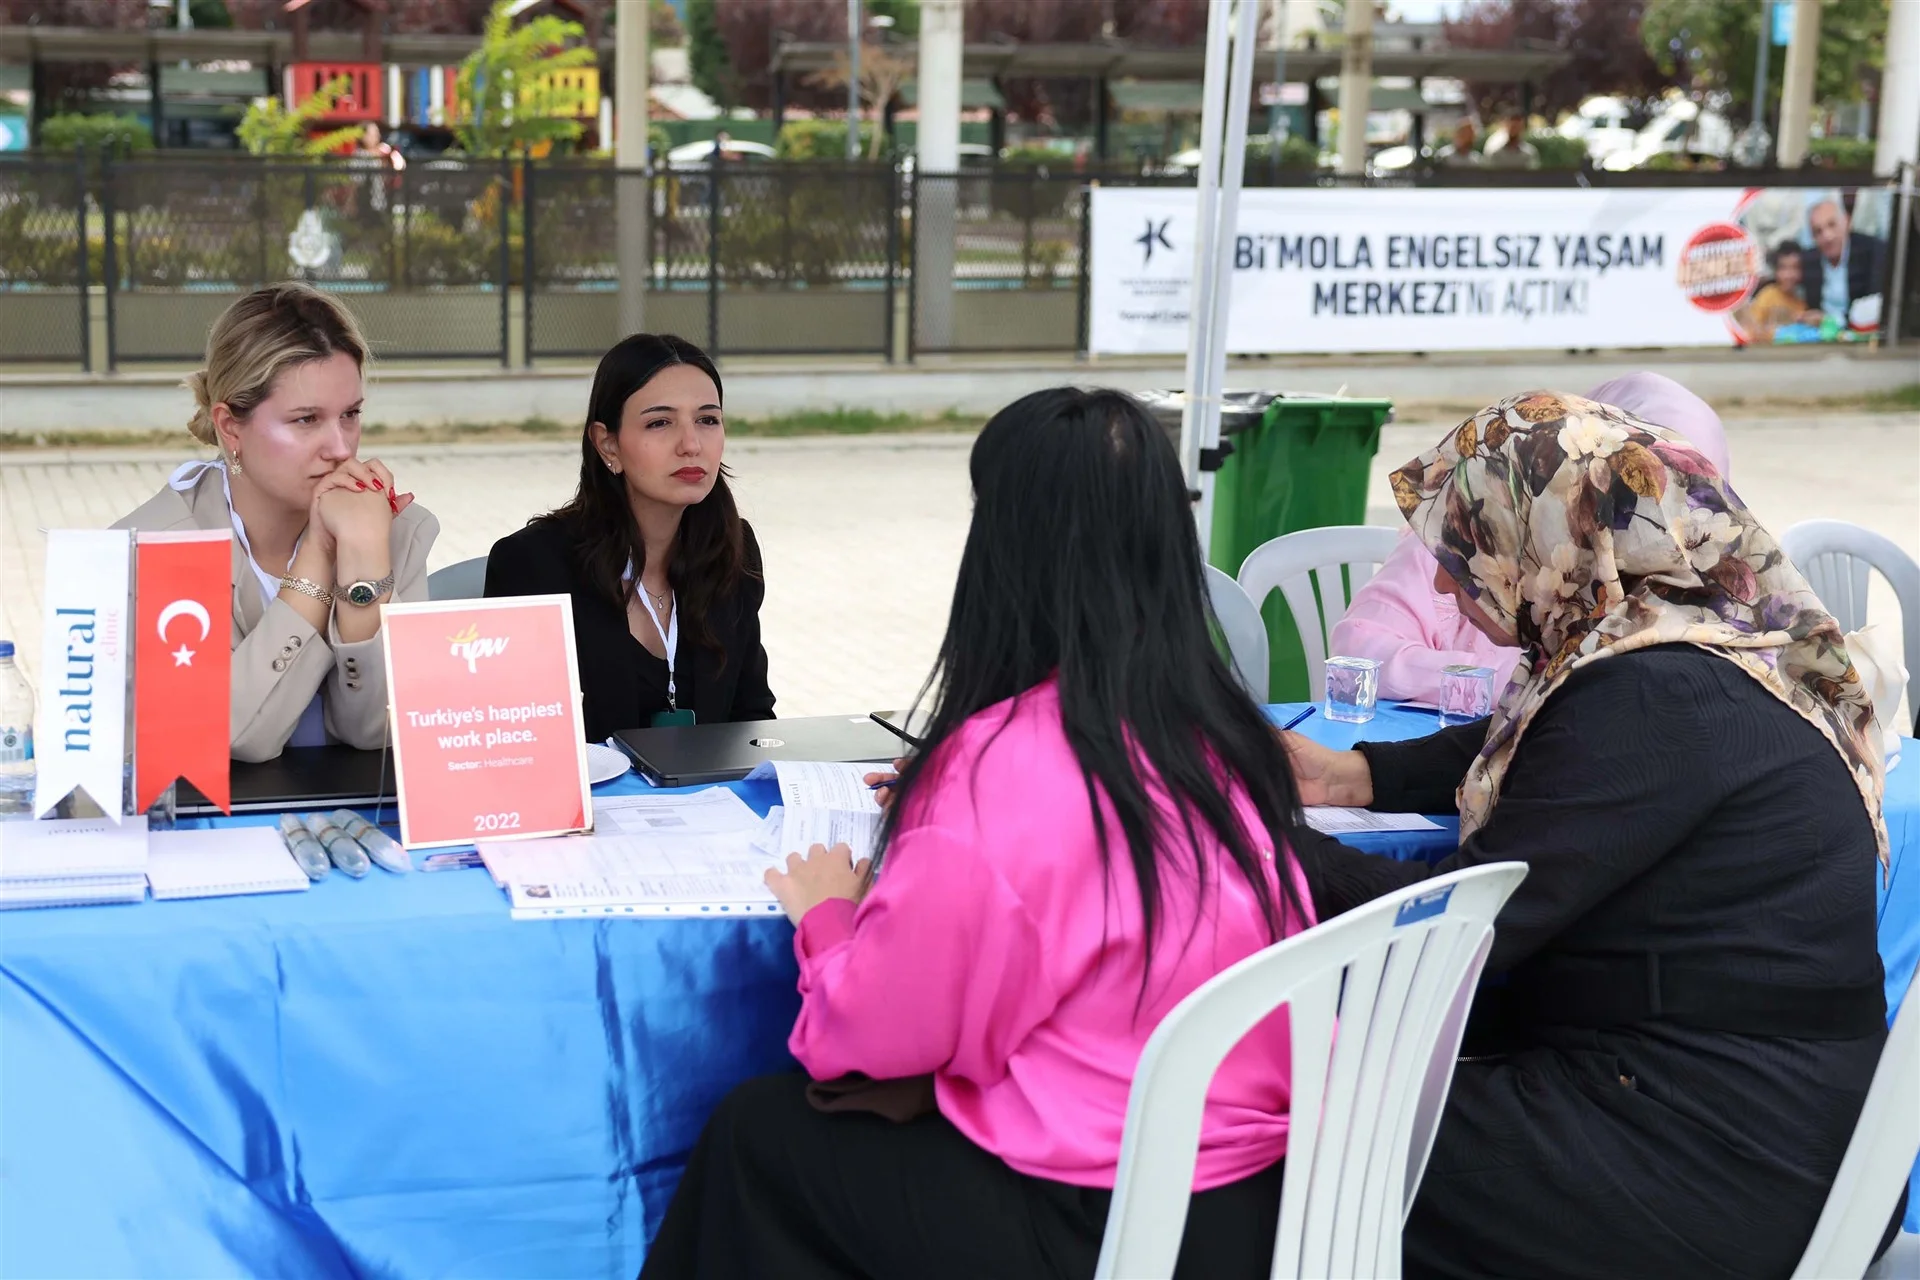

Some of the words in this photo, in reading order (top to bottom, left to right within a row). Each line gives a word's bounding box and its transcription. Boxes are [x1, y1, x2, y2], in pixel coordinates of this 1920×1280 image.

[1553, 234, 1664, 274] YAŞAM
[56, 606, 96, 752] natural
[406, 706, 484, 728] Turkiye's
[488, 701, 563, 725] happiest
[437, 731, 482, 749] work
[486, 728, 537, 749] place.
[447, 760, 482, 771] Sector:
[484, 755, 534, 768] Healthcare
[473, 812, 520, 831] 2022
